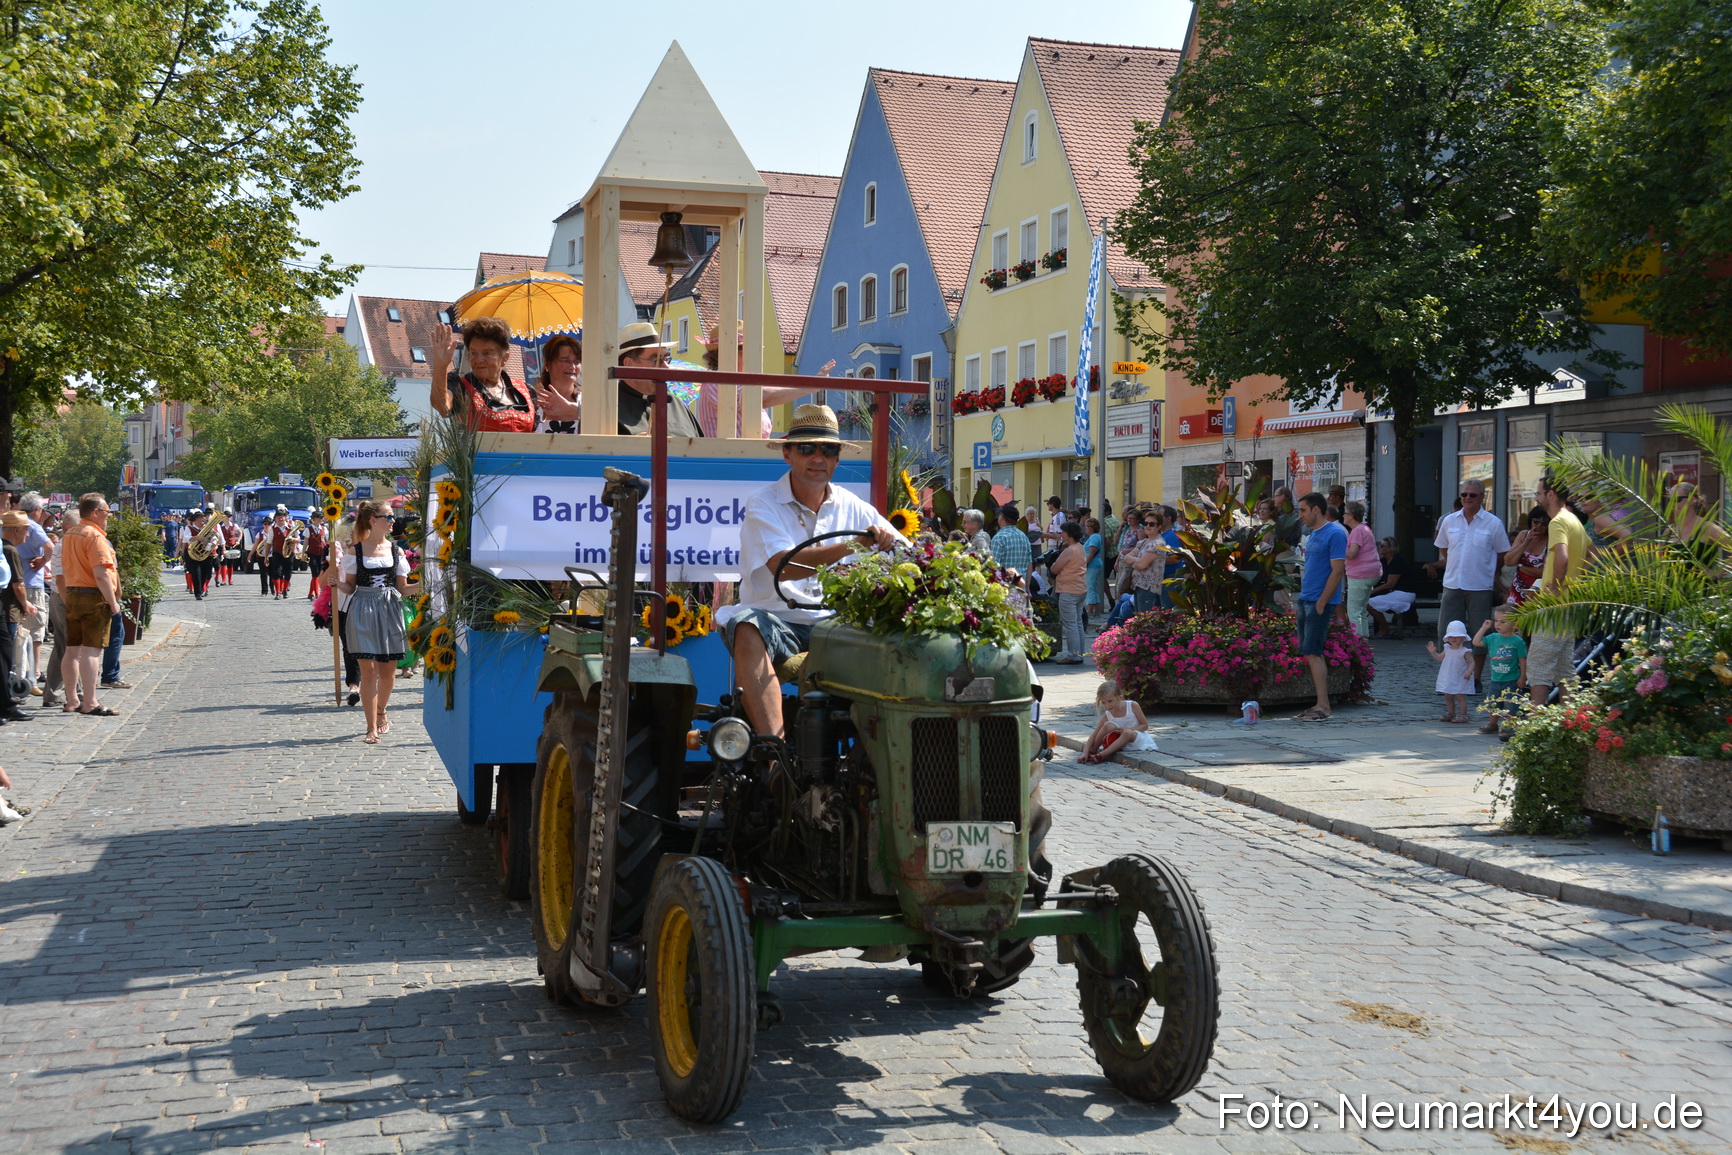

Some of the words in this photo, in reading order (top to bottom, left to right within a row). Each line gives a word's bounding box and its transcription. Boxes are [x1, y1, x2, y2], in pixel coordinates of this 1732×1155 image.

[1117, 363, 1134, 372] KINO
[935, 392, 946, 446] WITTL
[1132, 423, 1143, 435] KINO
[1152, 403, 1160, 452] KINO
[1211, 415, 1223, 426] DE
[339, 448, 416, 459] Weiberfasching
[575, 542, 606, 564] im
[957, 825, 989, 847] NM
[933, 848, 964, 869] DR
[984, 849, 1007, 869] 46
